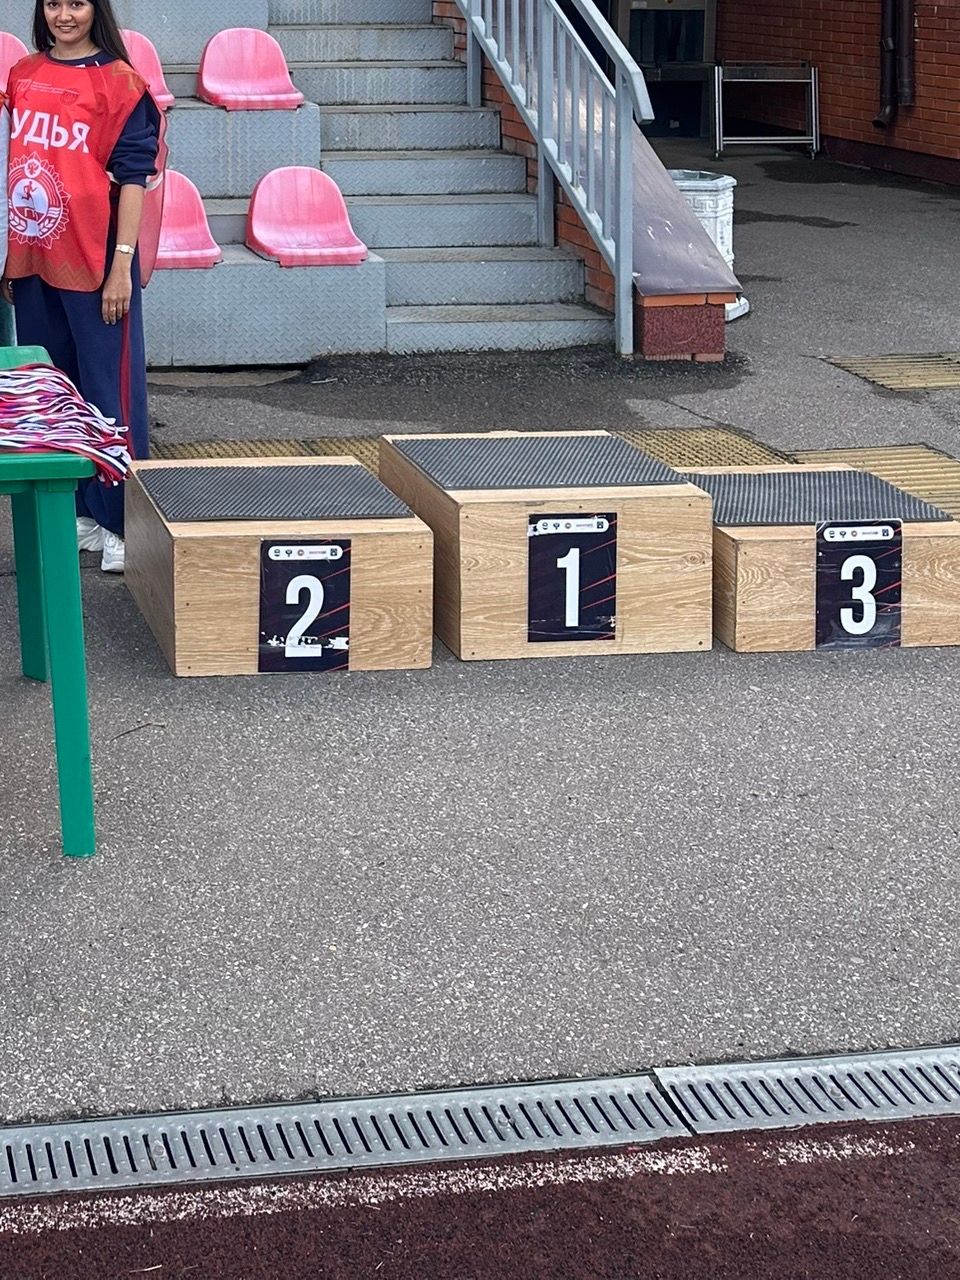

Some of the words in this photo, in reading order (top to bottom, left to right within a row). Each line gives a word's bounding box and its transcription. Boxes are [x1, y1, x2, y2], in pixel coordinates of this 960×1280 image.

[10, 107, 91, 154] УДЬЯ
[284, 574, 324, 658] 2
[556, 547, 580, 628] 1
[840, 554, 877, 635] 3
